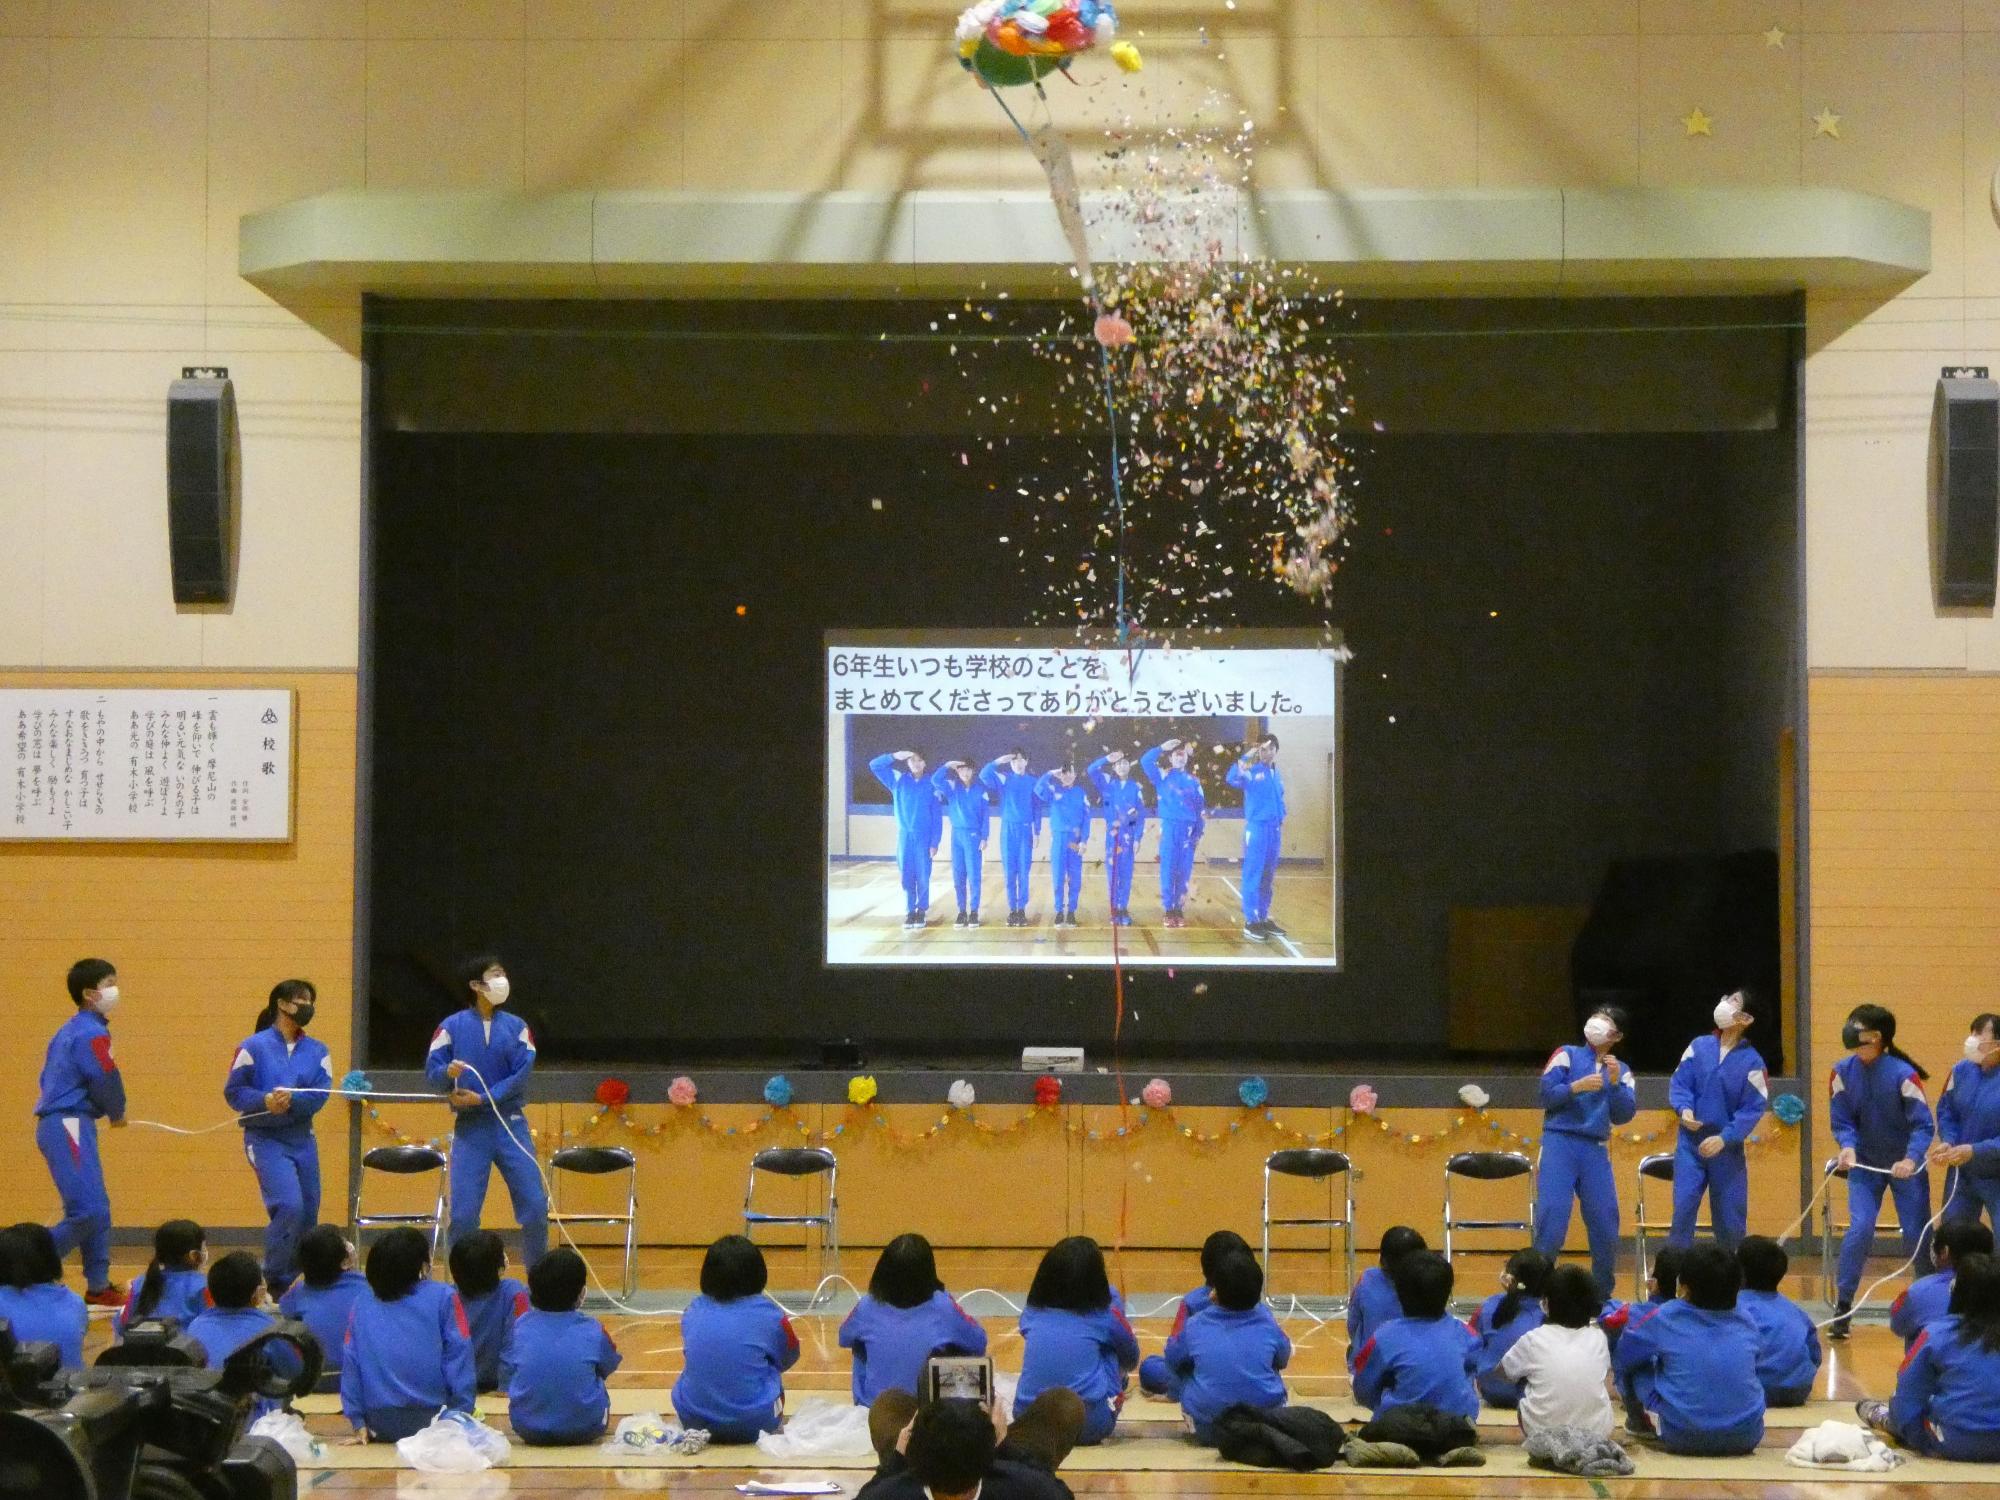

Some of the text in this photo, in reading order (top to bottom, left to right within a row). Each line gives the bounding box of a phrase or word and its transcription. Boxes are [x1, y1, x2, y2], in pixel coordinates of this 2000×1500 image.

[833, 653, 1101, 680] 6年生いつも学校のことを
[835, 688, 1303, 715] まとめてくださってありがとうございました。
[160, 709, 171, 770] みんな仲よく
[176, 710, 187, 771] 明るい元気な
[261, 736, 276, 776] 校歌
